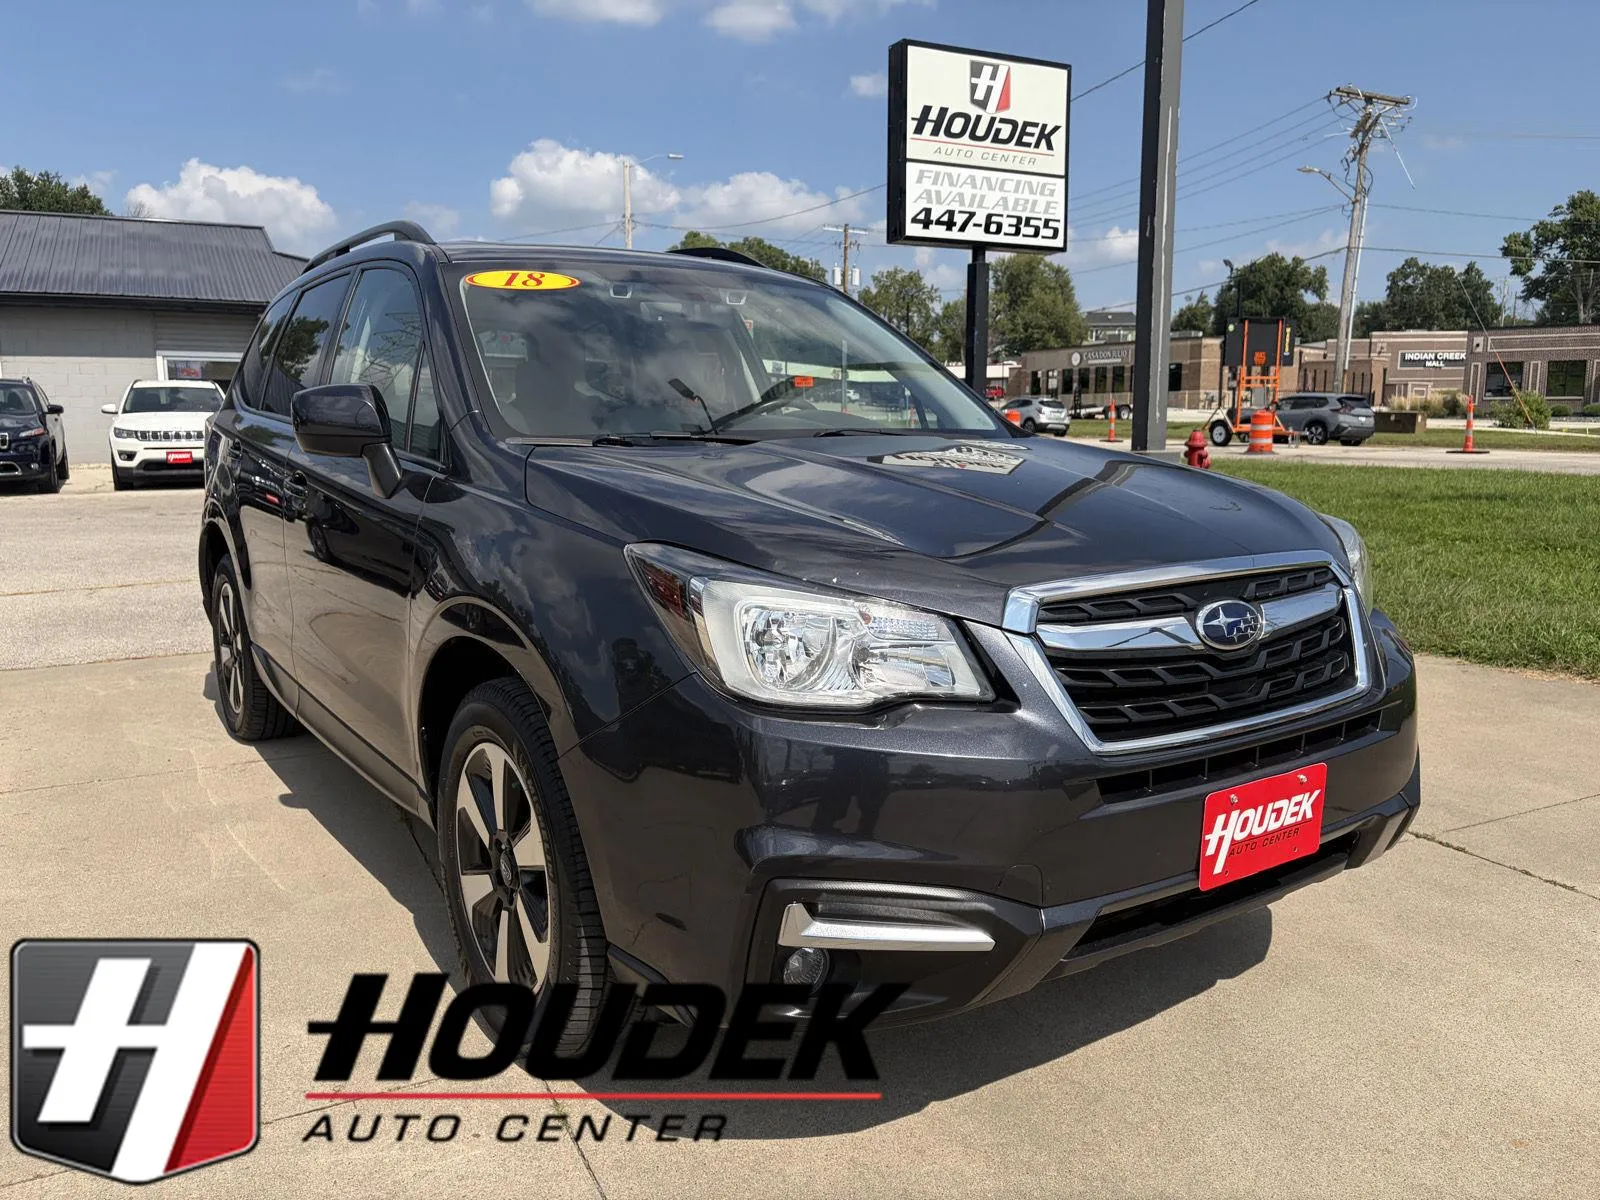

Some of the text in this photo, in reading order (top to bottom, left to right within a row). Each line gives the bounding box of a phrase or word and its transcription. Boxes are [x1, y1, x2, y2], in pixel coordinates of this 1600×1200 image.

[911, 105, 1062, 151] HOUDEK
[934, 147, 1037, 166] AUTO CENTER
[915, 169, 1057, 197] FINANCING
[913, 188, 1059, 215] AVAILABLE
[911, 207, 1061, 240] 447-6355
[501, 272, 546, 287] 18
[1083, 351, 1099, 360] CASA
[1405, 352, 1466, 360] INDIAN CREEK
[1205, 789, 1321, 875] HOUDEK
[1228, 827, 1300, 857] AUTO CENTER
